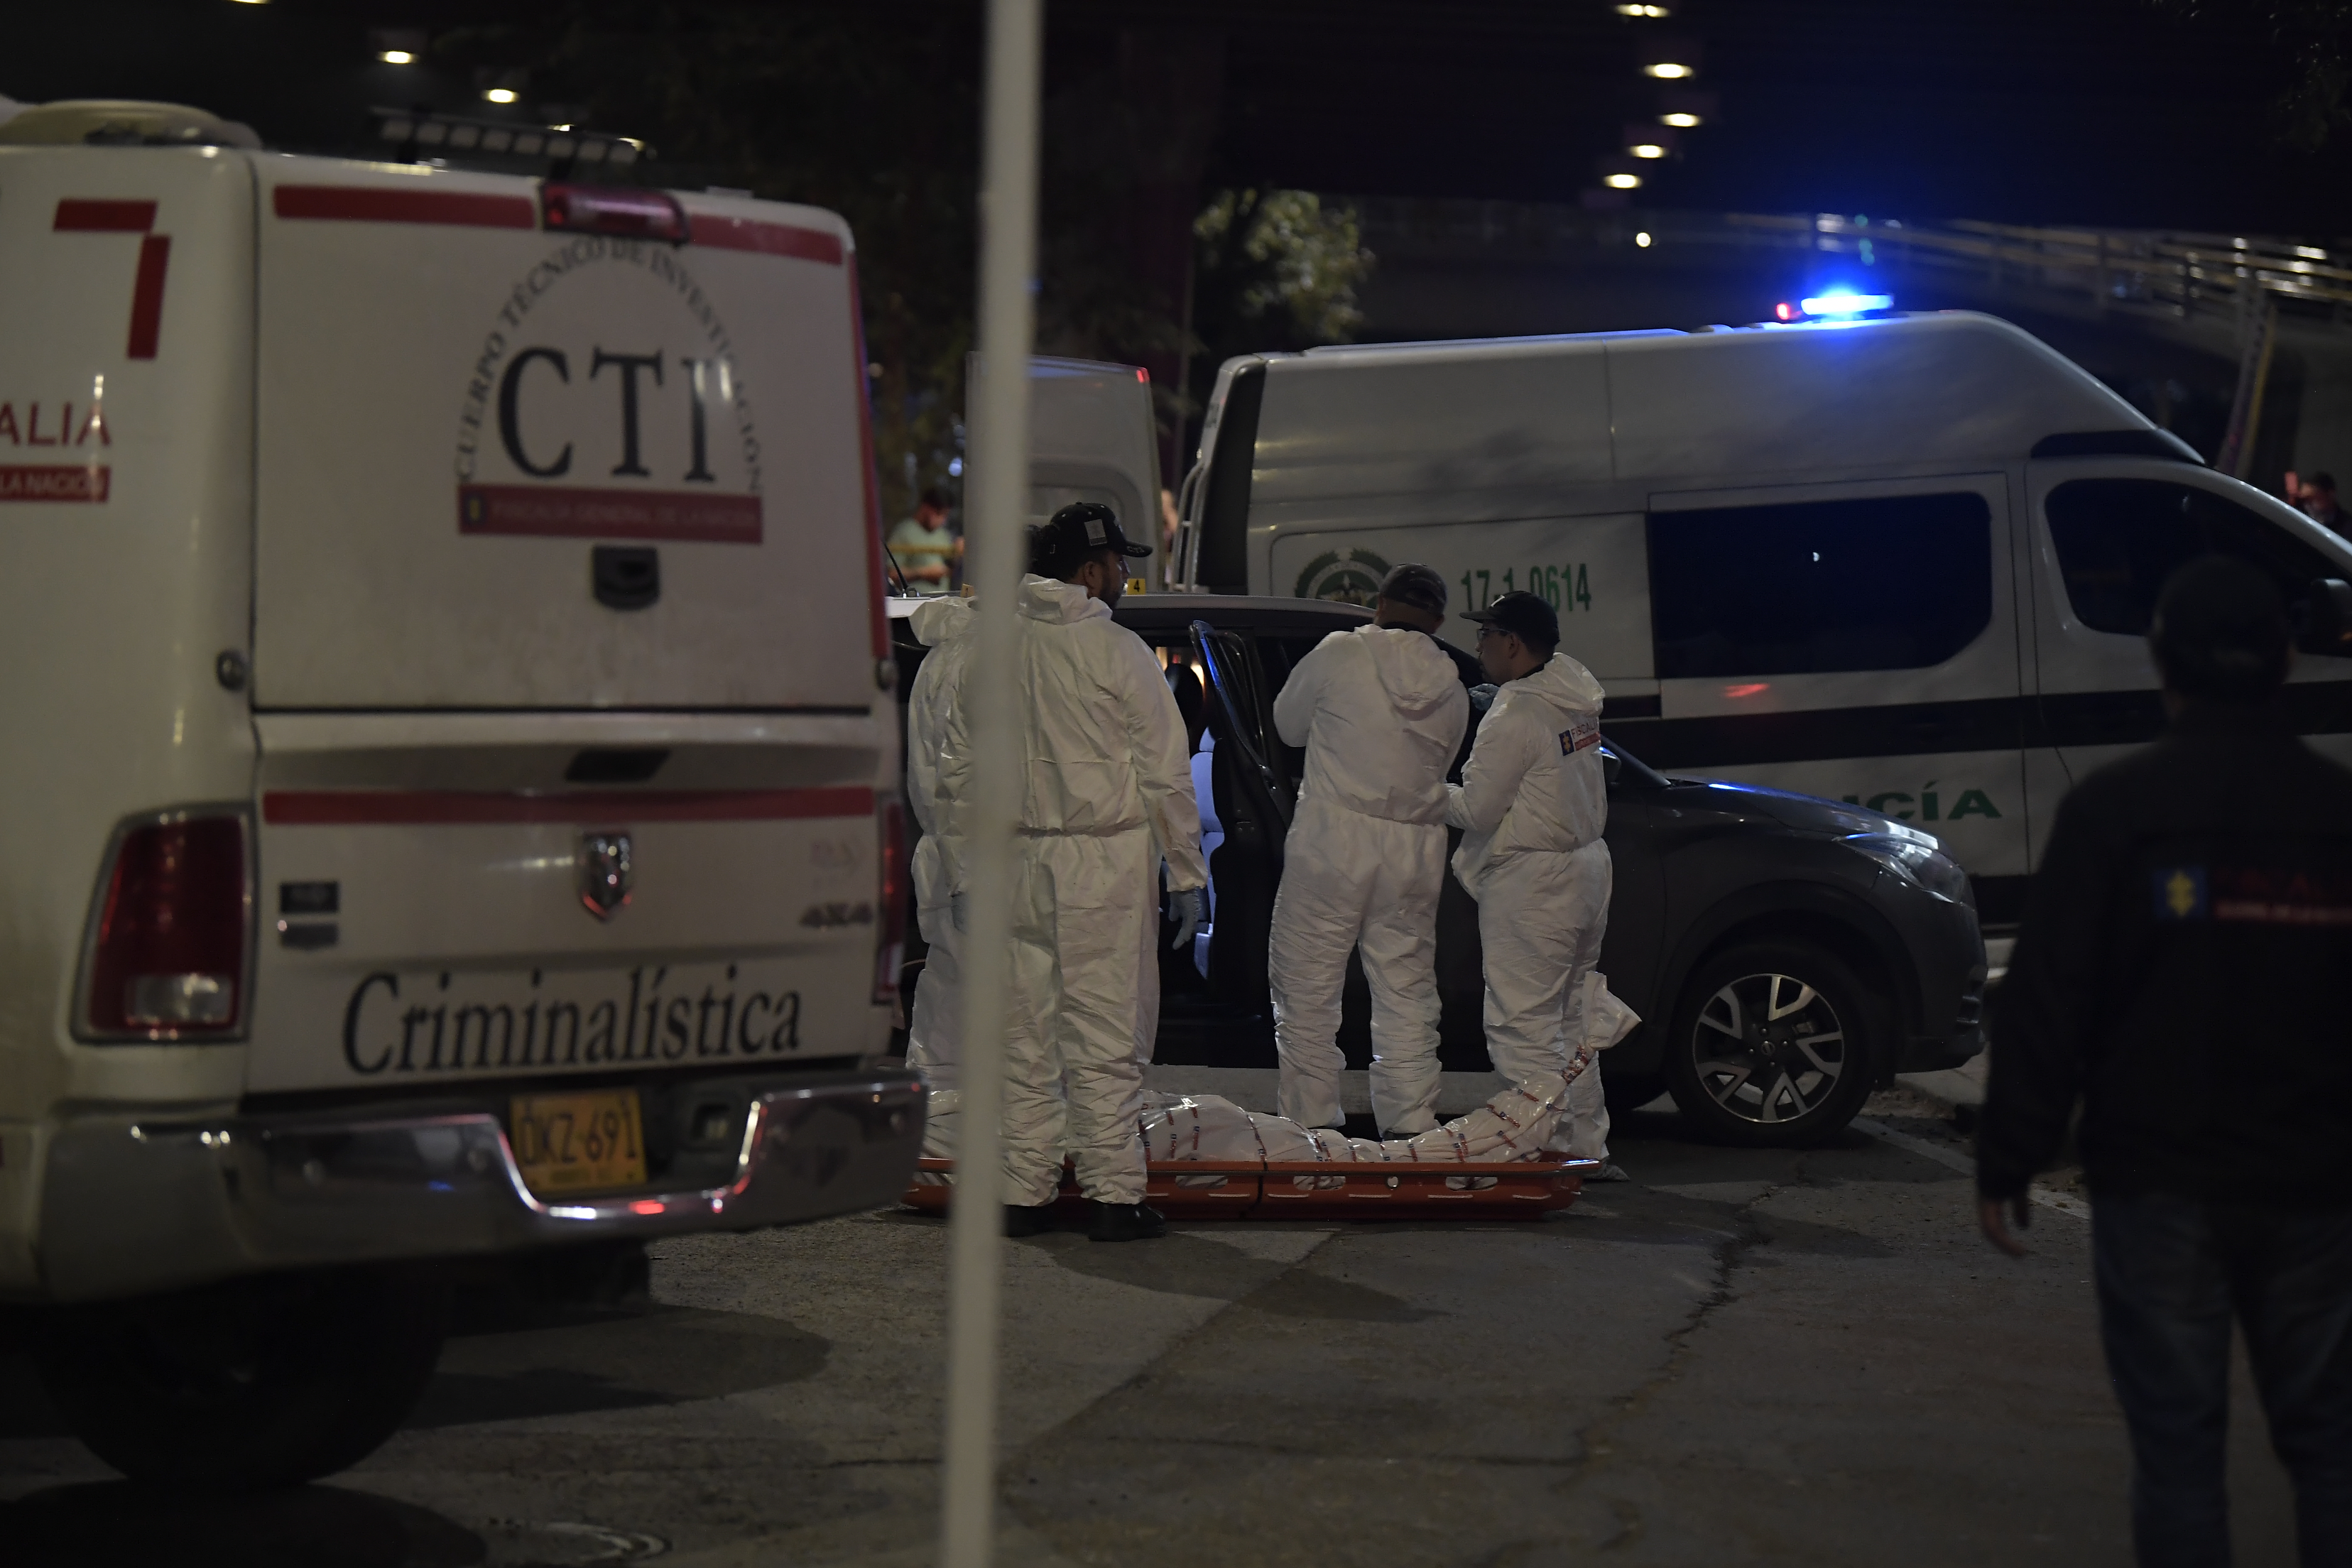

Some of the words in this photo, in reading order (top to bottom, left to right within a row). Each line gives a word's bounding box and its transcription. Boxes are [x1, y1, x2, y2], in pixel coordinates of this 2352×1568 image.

[498, 343, 717, 482] CTI
[1133, 579, 1140, 593] 4
[342, 965, 803, 1075] Criminalística
[585, 1108, 637, 1162] 691
